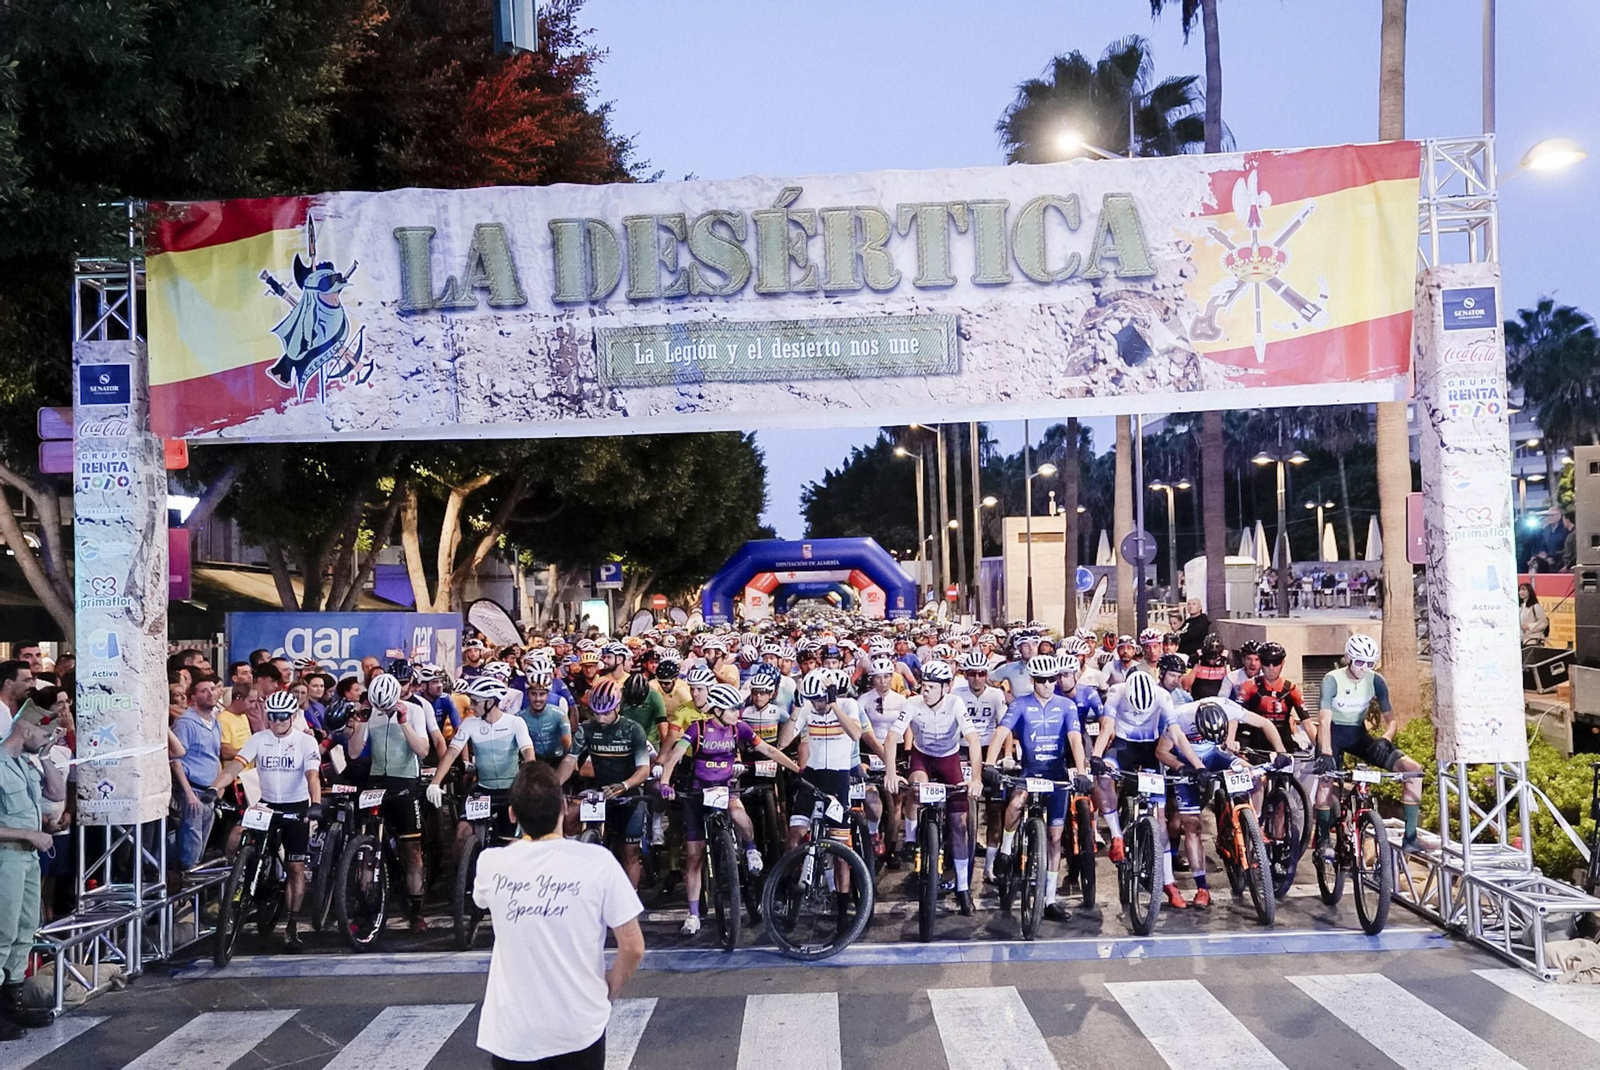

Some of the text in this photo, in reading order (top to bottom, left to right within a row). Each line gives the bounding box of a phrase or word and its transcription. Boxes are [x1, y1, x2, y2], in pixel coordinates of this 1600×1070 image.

[392, 186, 1158, 311] LA DESÉRTICA
[1454, 308, 1485, 316] SENATOR
[634, 335, 920, 366] La Legión y el desierto nos une
[1448, 378, 1497, 387] GRUPO
[1448, 387, 1499, 402] RENTA
[82, 452, 128, 460] GRUPO
[82, 462, 129, 474] RENTA
[1454, 528, 1509, 542] primaflor
[601, 564, 615, 581] P
[80, 597, 132, 610] primaflor
[1472, 603, 1501, 611] Activa
[285, 627, 359, 659] gar
[1230, 774, 1250, 785] 6762
[925, 787, 944, 795] 7884
[592, 805, 598, 814] 5
[256, 812, 263, 822] 3
[492, 873, 582, 901] Pepe Yepes
[506, 898, 569, 924] Speaker
